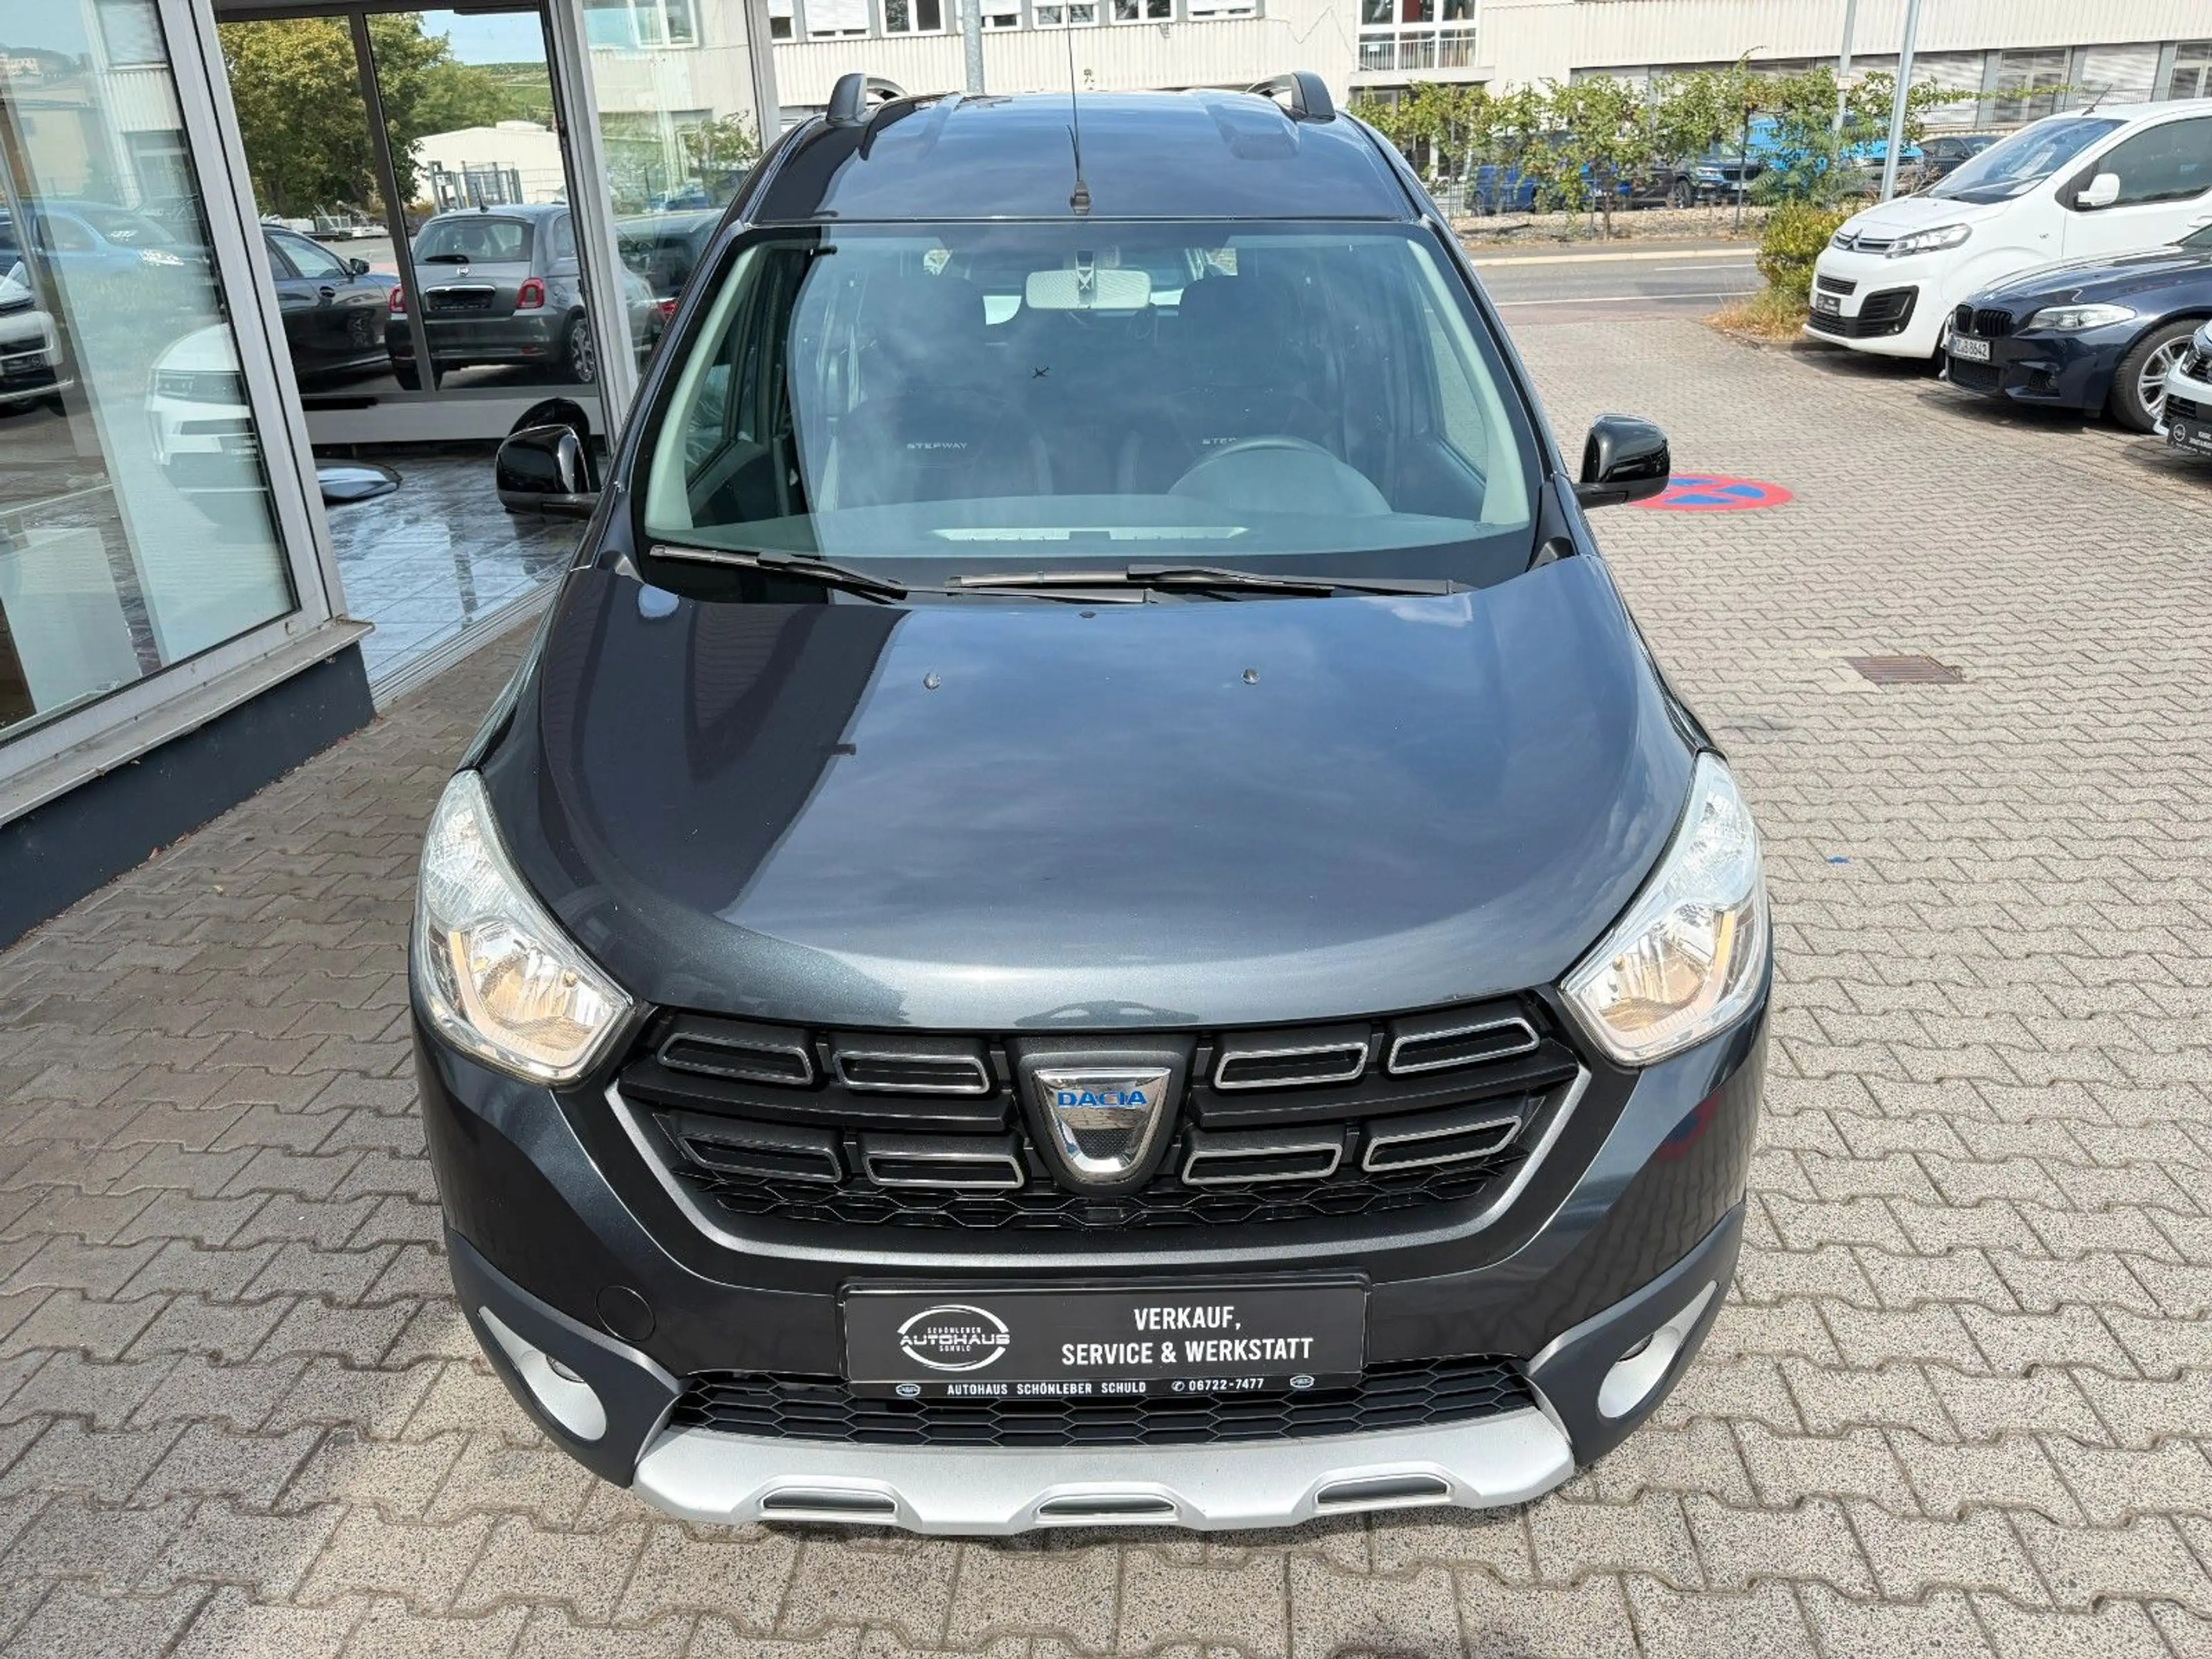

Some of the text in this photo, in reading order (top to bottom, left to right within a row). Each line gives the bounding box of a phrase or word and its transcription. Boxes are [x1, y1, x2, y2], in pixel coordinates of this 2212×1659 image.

[1058, 1090, 1147, 1107] DACIA
[1134, 1306, 1241, 1330] VERKAUF,
[900, 1334, 1010, 1346] AUTOHAUS
[1062, 1337, 1314, 1365] SERVICE & WERKSTATT
[947, 1377, 1264, 1395] AUTOHAUS SCHÖNLEBER SCHULD 06722-7477
